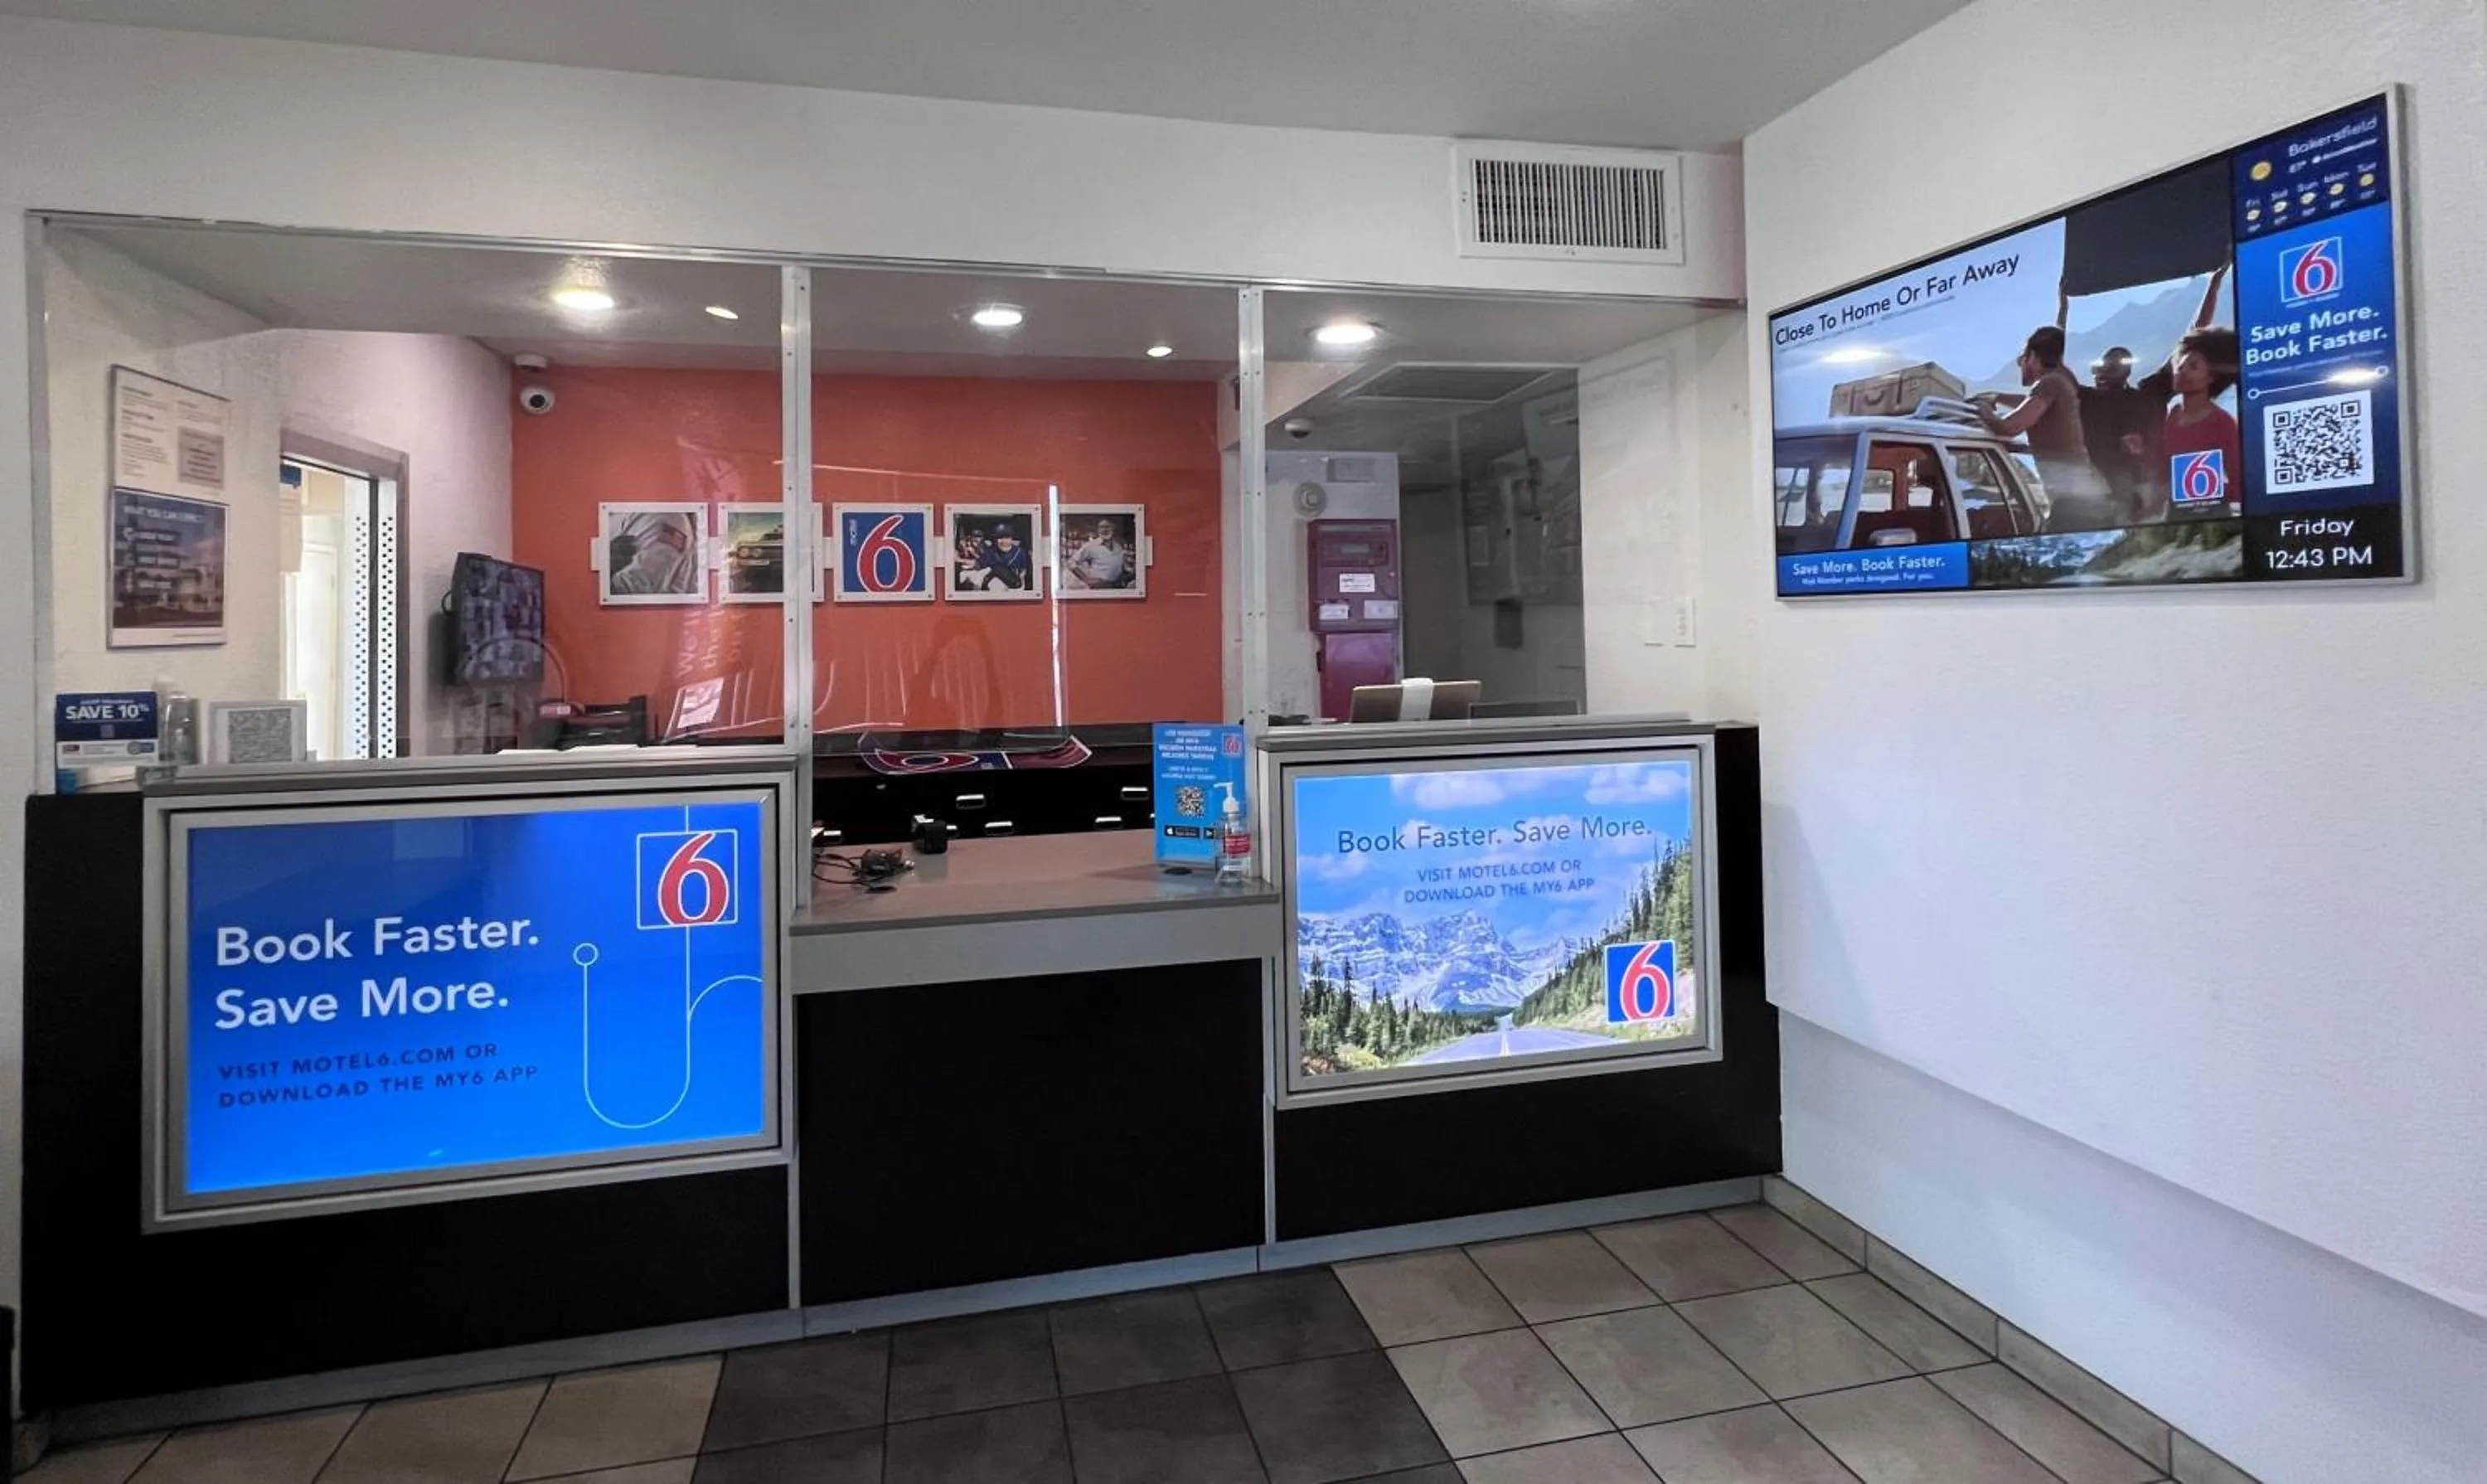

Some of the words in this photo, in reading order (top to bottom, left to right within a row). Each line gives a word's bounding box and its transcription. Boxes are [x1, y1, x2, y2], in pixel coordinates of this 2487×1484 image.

[2288, 116, 2378, 157] Bakersfield
[2292, 240, 2337, 298] 6
[1776, 323, 1814, 345] Close
[1819, 314, 1836, 329] To
[1841, 297, 1890, 323] Home
[1897, 287, 1922, 306] Or
[1927, 276, 1956, 298] Far
[1962, 254, 2019, 286] Away
[2251, 322, 2301, 343] Save
[2310, 306, 2379, 330] More.
[2246, 340, 2301, 365] Book
[2309, 326, 2388, 352] Faster.
[2182, 452, 2219, 499] 6
[2281, 516, 2354, 537] Friday
[857, 514, 915, 594] 6
[1793, 563, 1818, 576] Save
[1861, 556, 1894, 571] Book
[1898, 555, 1945, 569] Faster.
[2266, 547, 2324, 570] 12:43
[2332, 546, 2373, 566] PM
[65, 705, 114, 720] SAVE
[1338, 826, 1406, 853] Book
[1418, 825, 1502, 849] Faster.
[1513, 820, 1570, 843] Save
[1582, 816, 1652, 840] More.
[657, 831, 730, 927] 6
[1403, 885, 1496, 903] DOWNLOAD
[1500, 881, 1527, 896] THE
[1533, 880, 1563, 895] MY6
[1568, 878, 1595, 891] APP
[1418, 867, 1452, 882] VISIT
[1458, 861, 1555, 880] MOTEL6.COM
[1560, 859, 1582, 873] OR
[217, 918, 354, 966] Book
[374, 916, 538, 956] Faster.
[1620, 941, 1670, 1022] 6
[215, 988, 339, 1030] Save
[361, 976, 508, 1018] More.
[218, 1060, 280, 1079] VISIT
[292, 1046, 455, 1074] MOTEL6.COM
[465, 1042, 498, 1060] OR
[219, 1079, 370, 1108] DOWNLOAD
[380, 1075, 424, 1094] THE
[435, 1071, 485, 1089] MY6
[493, 1065, 539, 1084] APP
